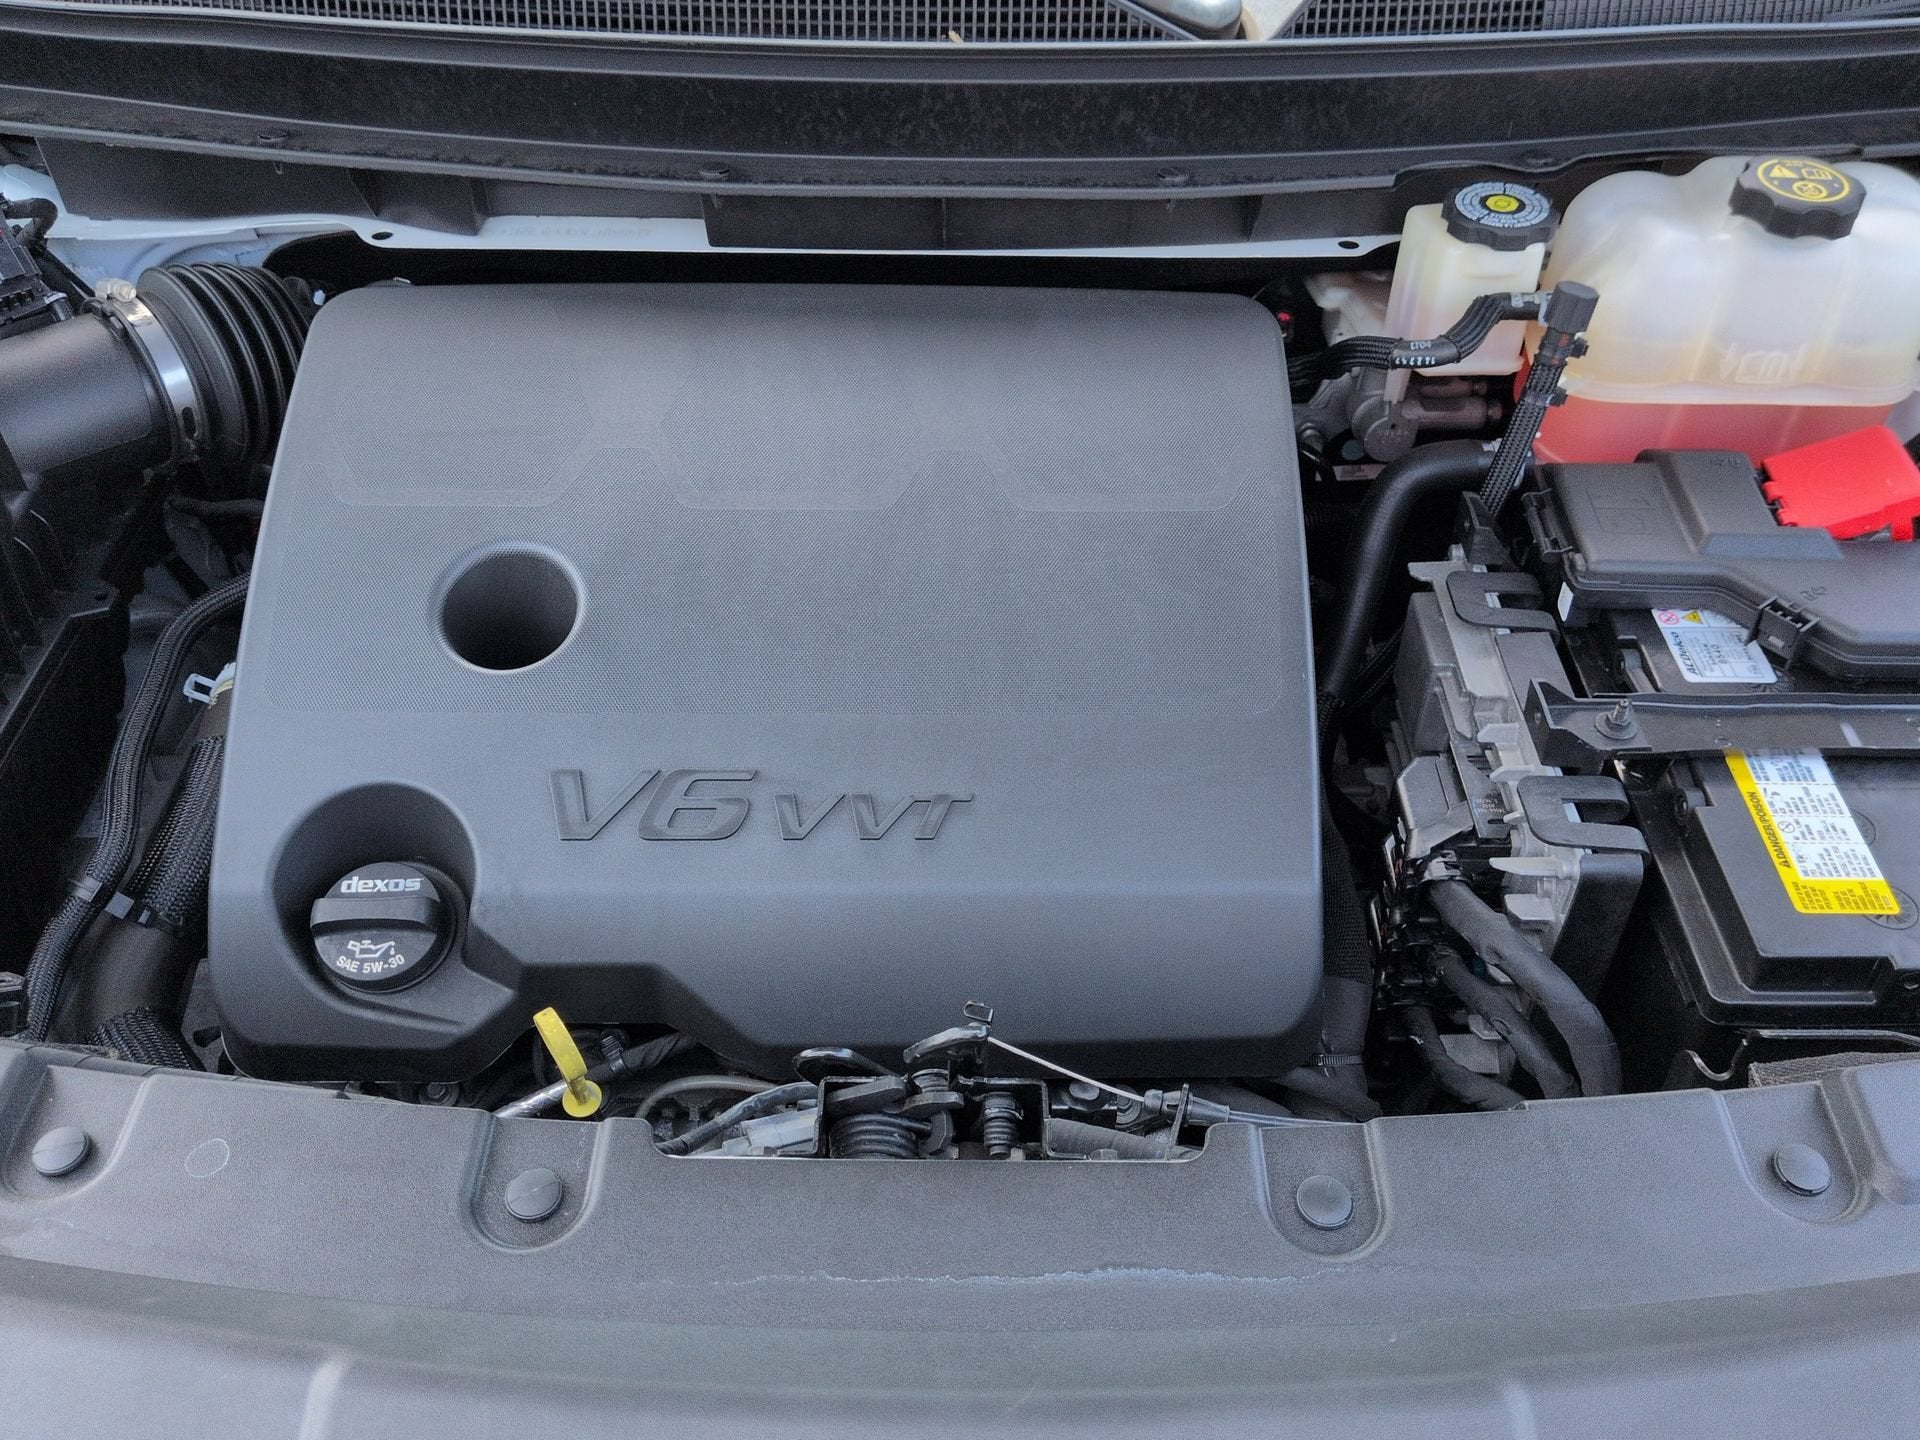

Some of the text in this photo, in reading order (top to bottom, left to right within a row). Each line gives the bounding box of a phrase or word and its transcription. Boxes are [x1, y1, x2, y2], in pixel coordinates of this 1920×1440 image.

[549, 768, 974, 842] V6 VVT
[340, 876, 421, 894] dexos
[336, 954, 405, 974] SAE 5W-30
